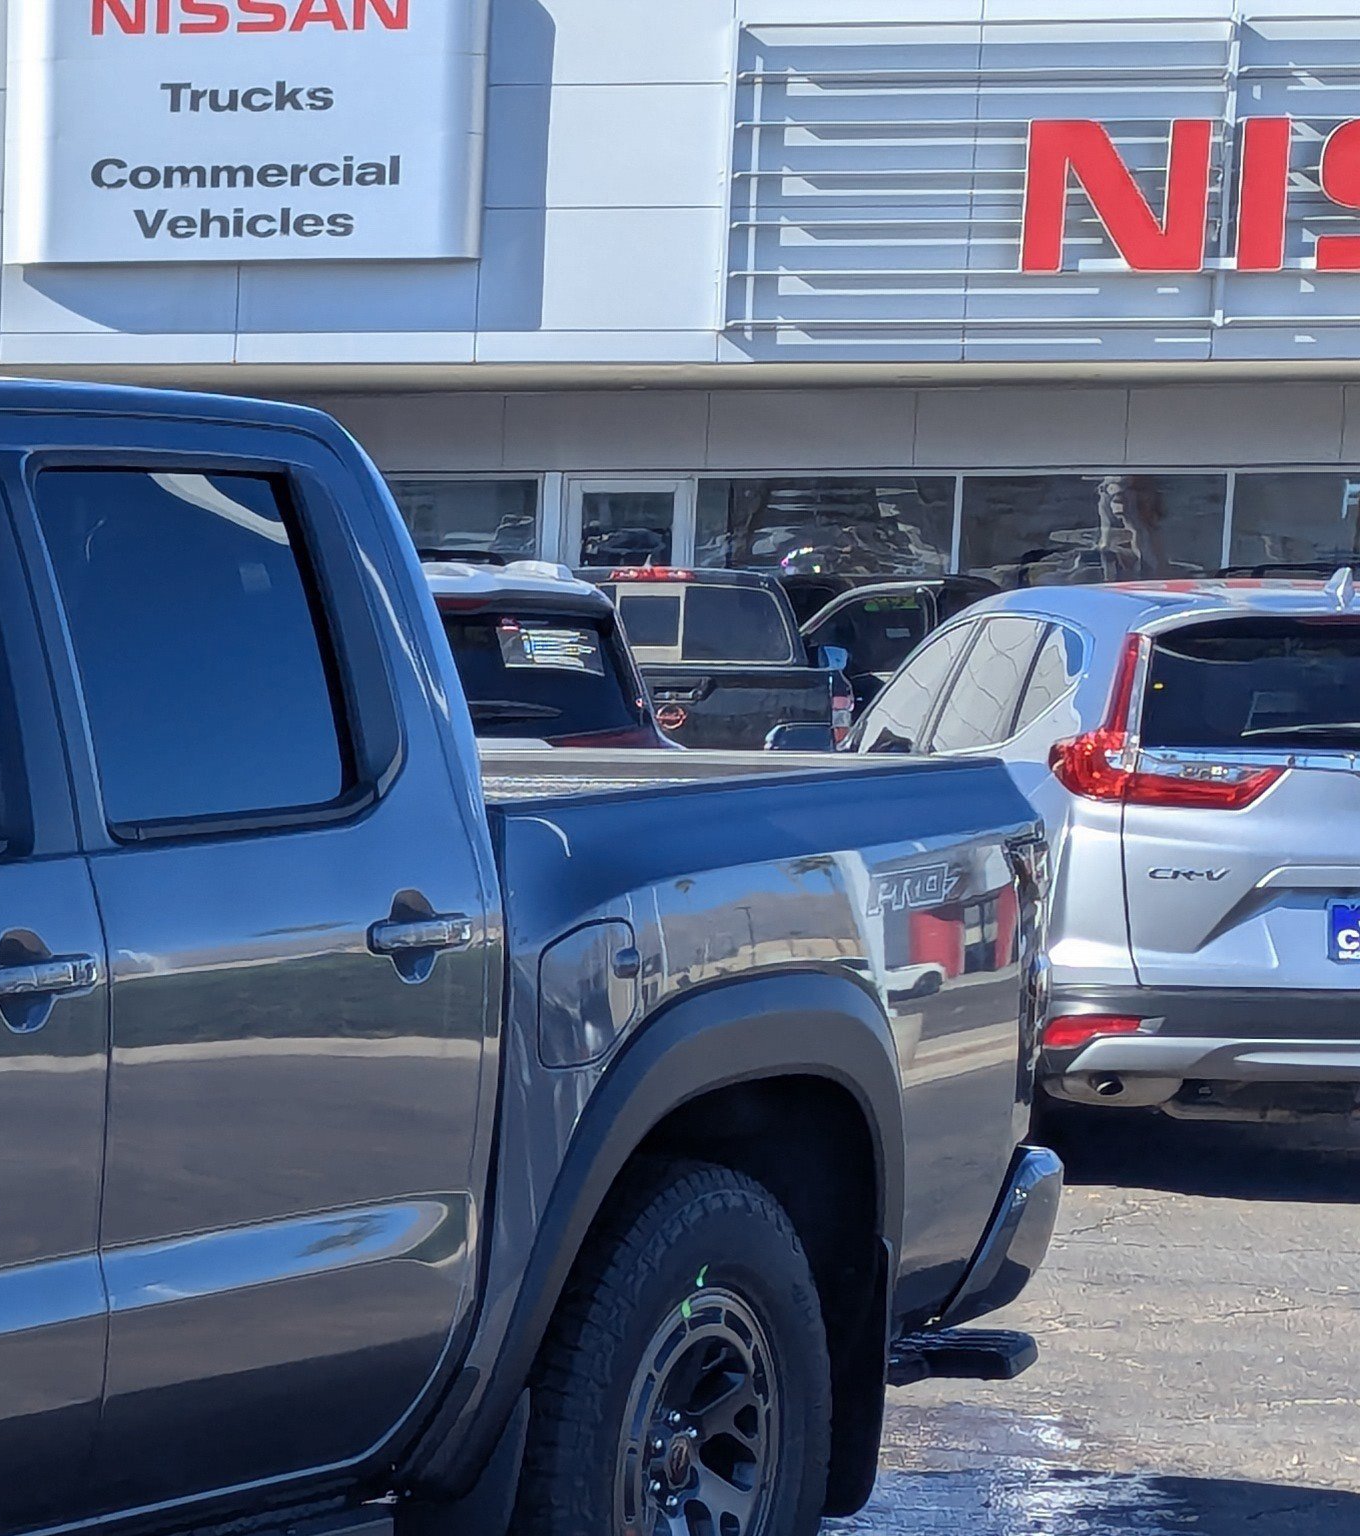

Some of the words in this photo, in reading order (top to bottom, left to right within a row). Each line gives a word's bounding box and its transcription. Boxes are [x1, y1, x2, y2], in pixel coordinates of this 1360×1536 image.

[91, 0, 409, 36] NISSAN
[160, 80, 335, 112] Trucks
[90, 155, 402, 190] Commercial
[1020, 117, 1360, 273] NI
[132, 206, 355, 239] Vehicles
[1147, 867, 1231, 882] CR-V
